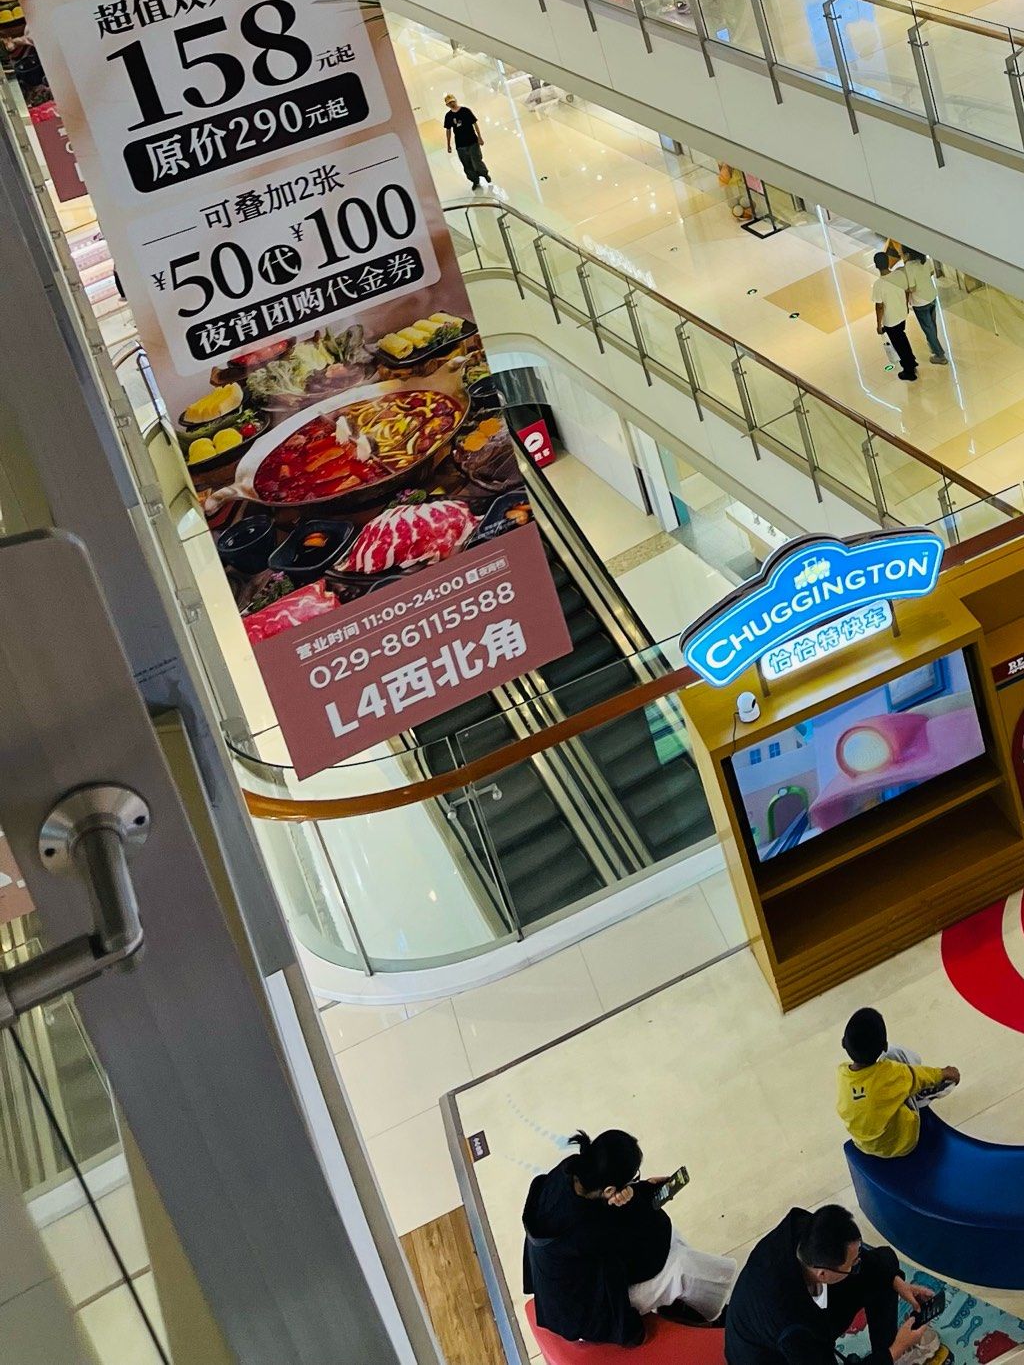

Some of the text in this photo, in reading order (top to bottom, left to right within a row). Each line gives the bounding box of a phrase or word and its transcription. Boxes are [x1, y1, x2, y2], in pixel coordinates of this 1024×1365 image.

[200, 164, 346, 231] 可叠加2张
[195, 253, 418, 354] 夜宵团购代金券
[295, 622, 361, 662] 营业时间
[361, 576, 464, 631] 11:00-24:00
[309, 581, 516, 689] 029-86115588
[705, 556, 929, 669] CHUGGINGTON
[768, 605, 888, 673] 恰恰特快车
[325, 618, 528, 738] L4西北角
